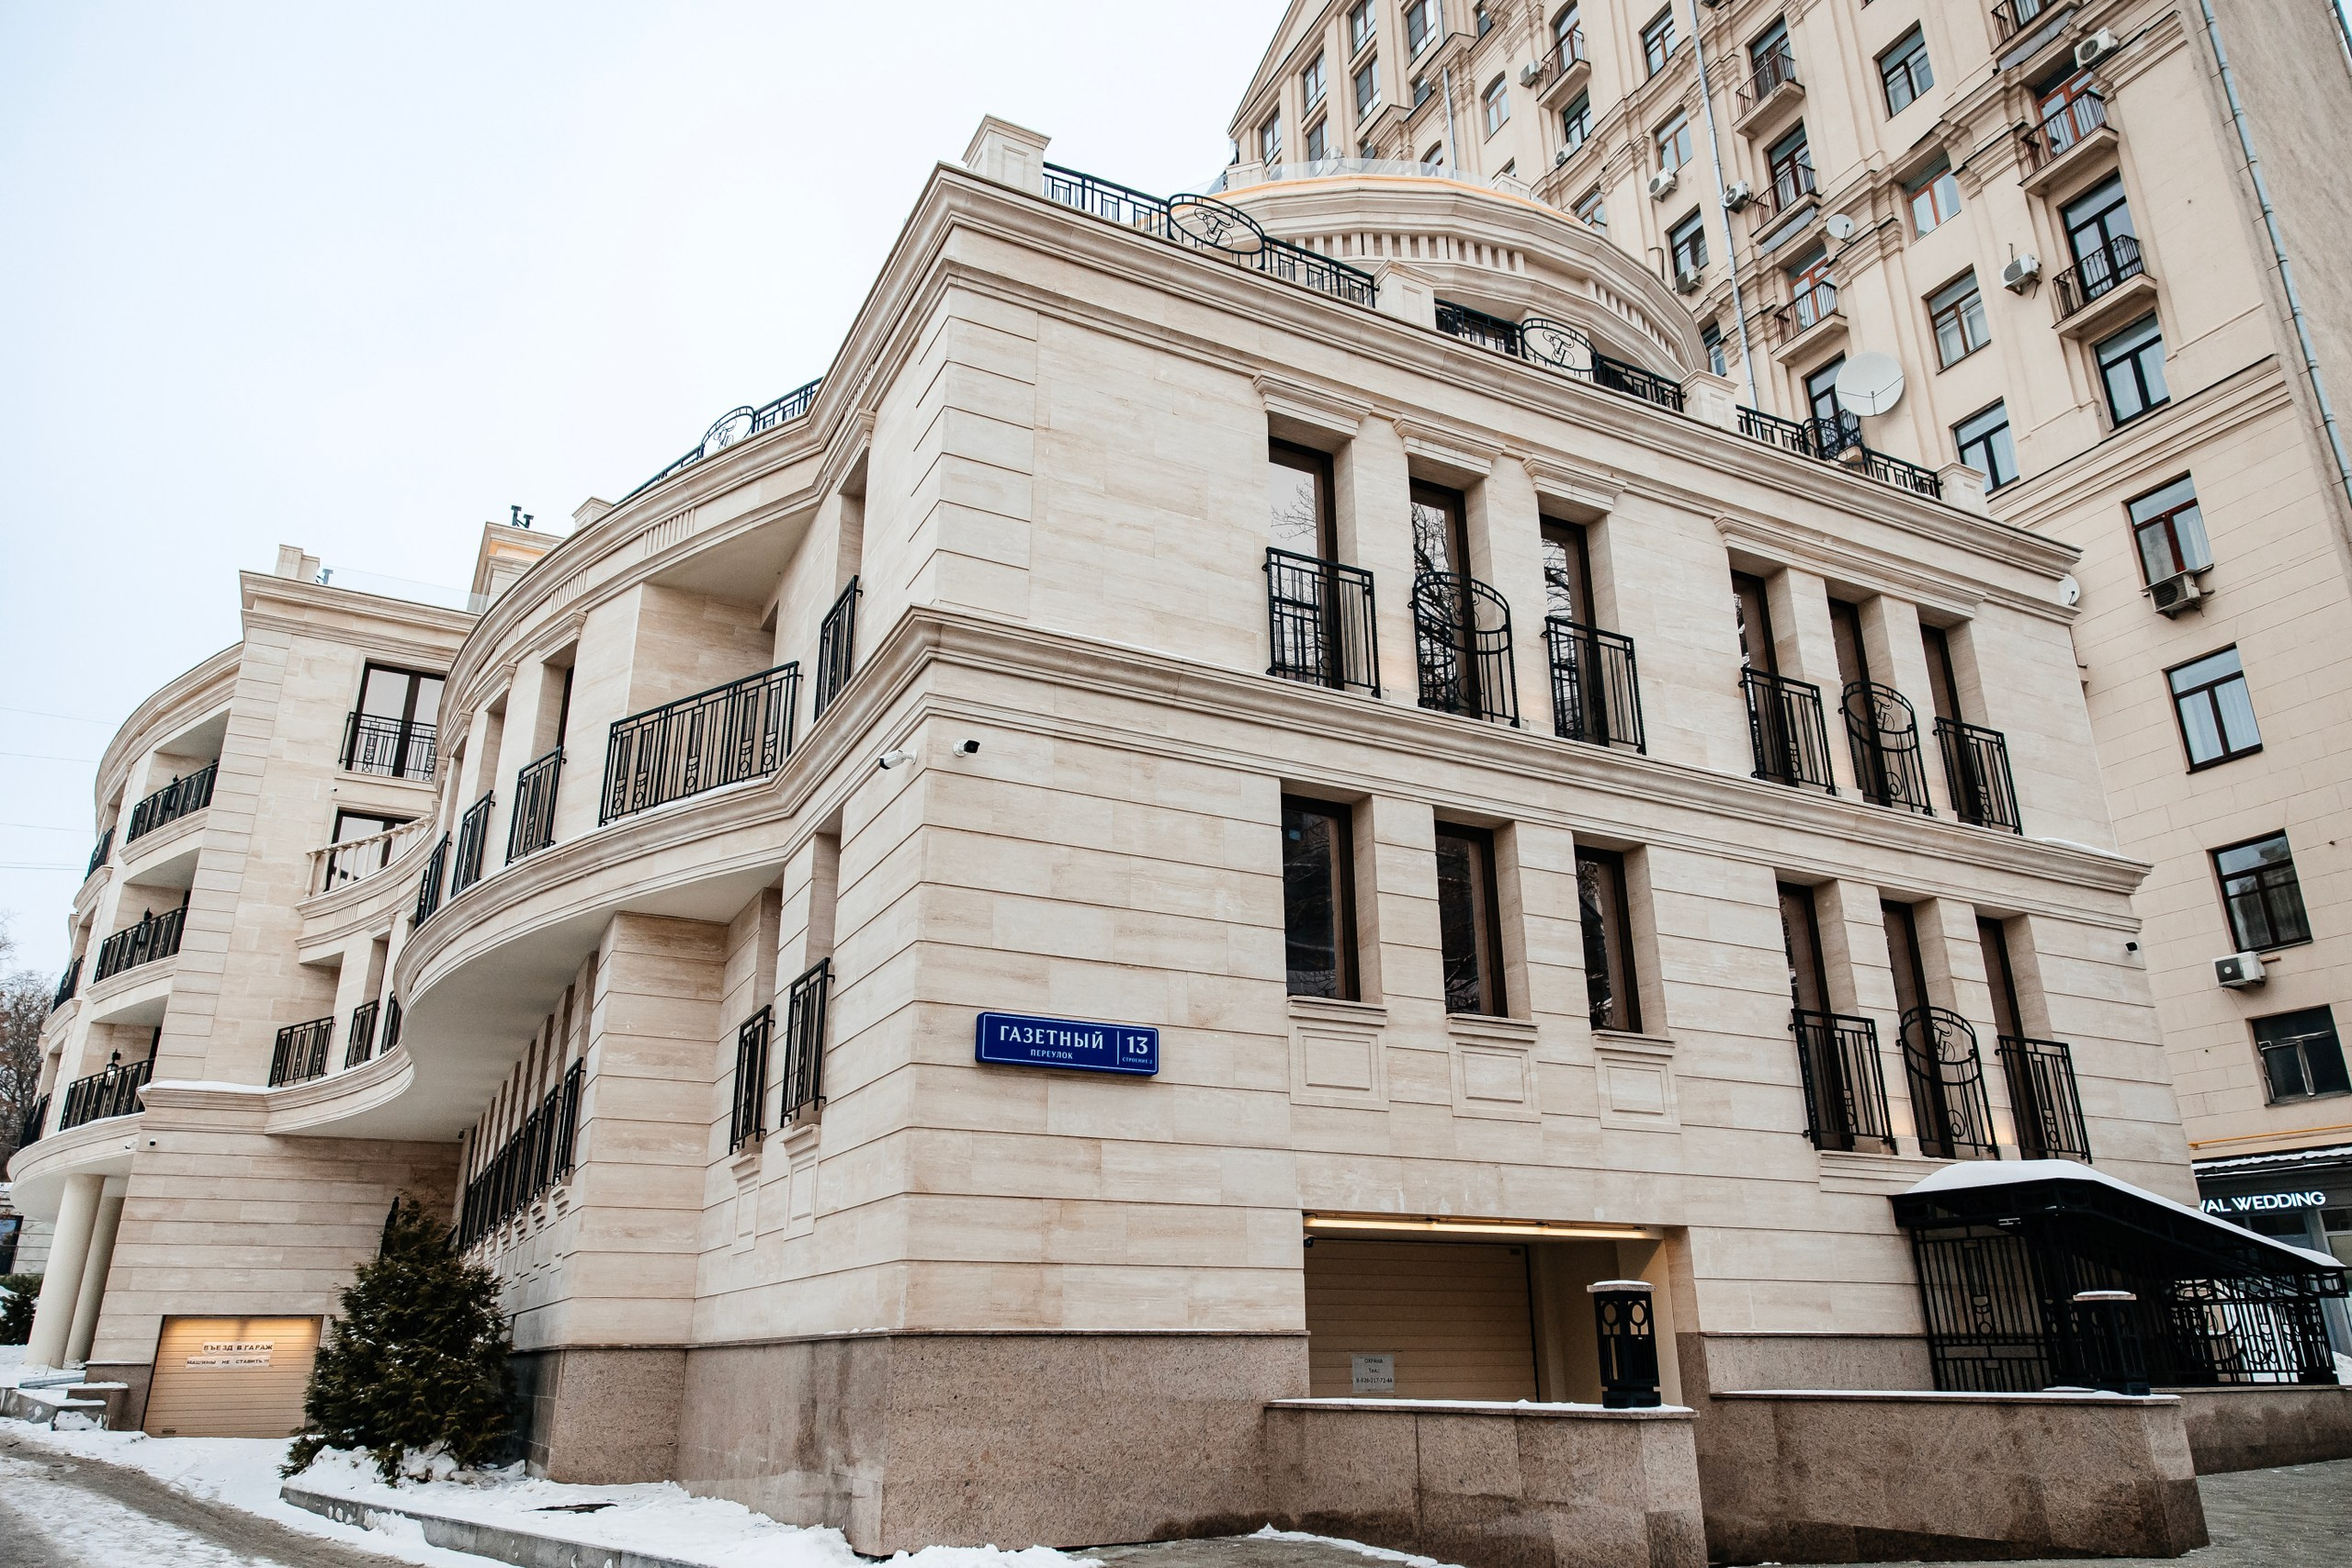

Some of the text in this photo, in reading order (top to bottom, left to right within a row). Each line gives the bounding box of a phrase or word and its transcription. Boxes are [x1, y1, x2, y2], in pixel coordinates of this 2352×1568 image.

[1000, 1024, 1103, 1050] ГАЗЕТНЫЙ
[1126, 1035, 1148, 1055] 13
[1030, 1048, 1073, 1060] ПЕРЕУЛОК
[1122, 1056, 1148, 1065] СТРОЕНИЕ
[2232, 1190, 2326, 1212] WEDDING
